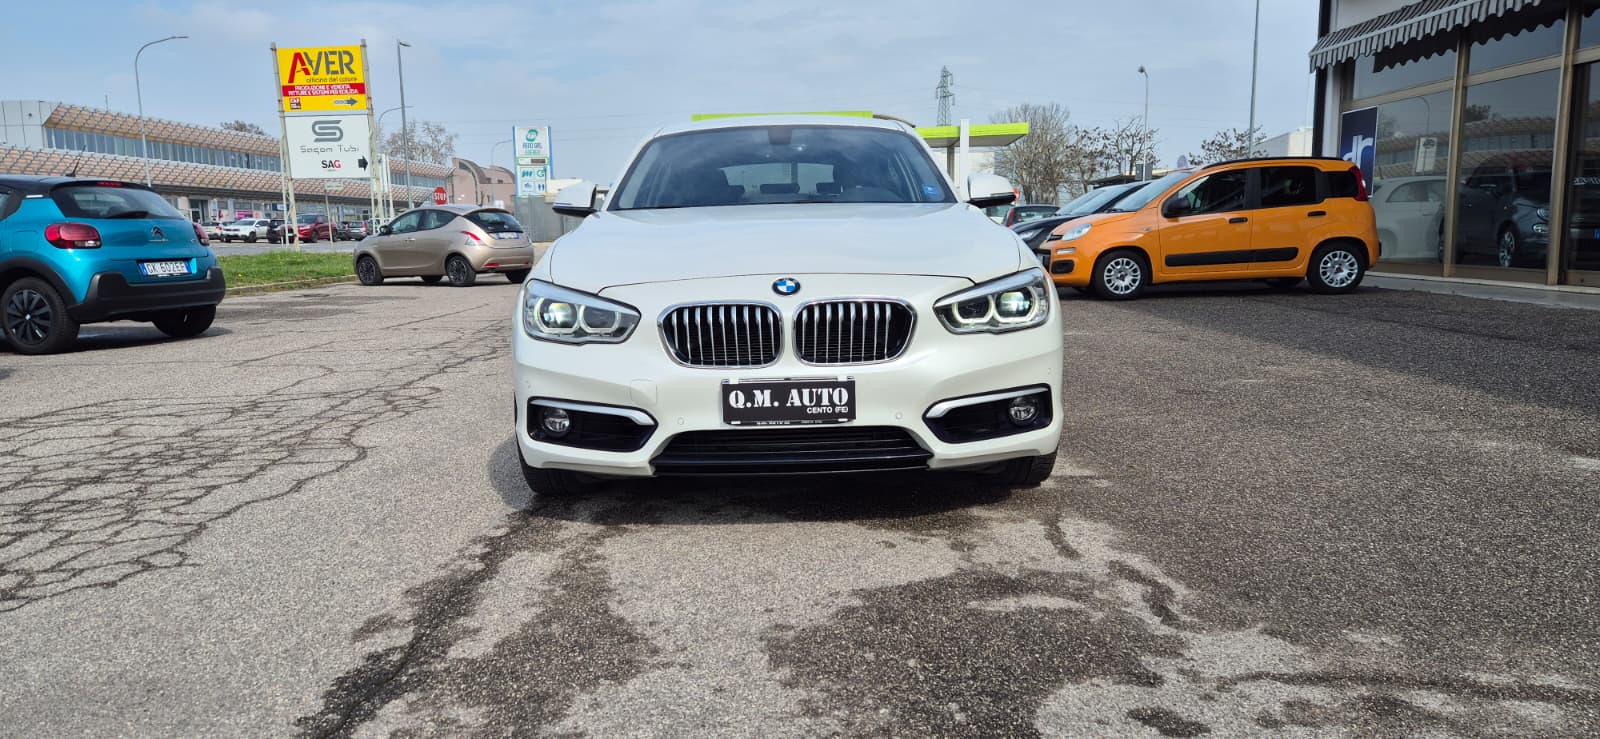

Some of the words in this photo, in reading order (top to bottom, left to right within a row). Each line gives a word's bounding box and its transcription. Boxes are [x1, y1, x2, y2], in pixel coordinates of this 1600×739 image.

[288, 50, 355, 83] AVER
[321, 160, 341, 168] SAG
[729, 389, 779, 408] Q.M.
[786, 387, 848, 406] AUTO
[807, 406, 833, 414] CENTO
